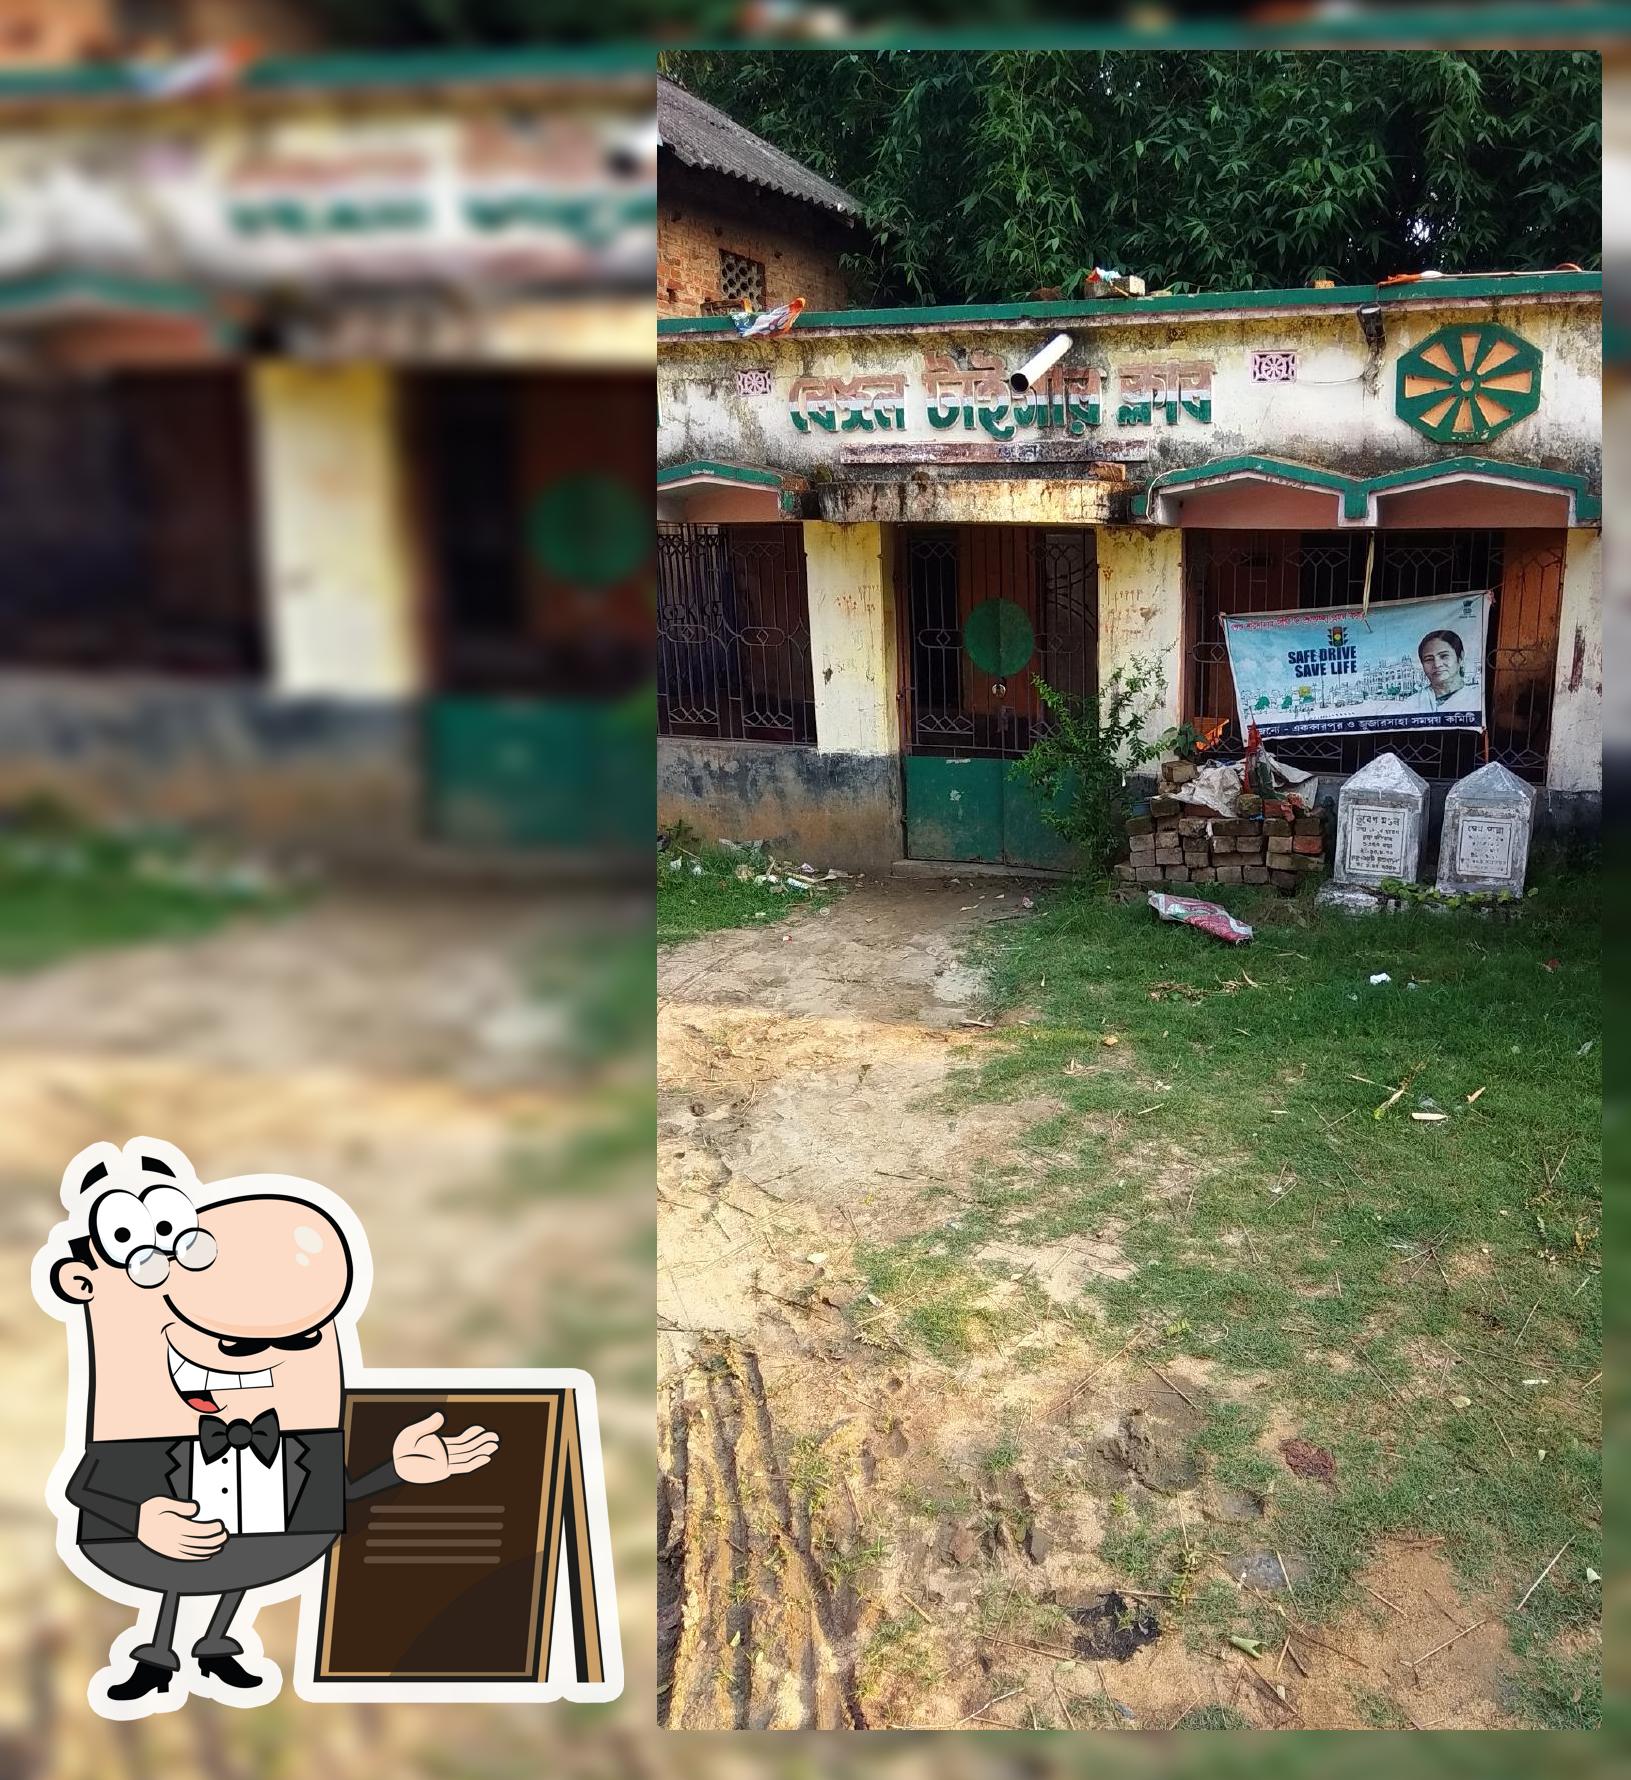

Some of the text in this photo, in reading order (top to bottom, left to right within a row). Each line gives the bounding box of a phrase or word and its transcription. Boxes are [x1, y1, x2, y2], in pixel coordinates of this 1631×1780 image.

[789, 350, 1216, 441] বেঙ্গল টাইগার ক্লাব
[1288, 646, 1357, 664] SAFE DRIVE
[1295, 661, 1357, 678] SAVE LIFE
[1347, 720, 1355, 729] ও
[1446, 712, 1476, 724] কমিটি
